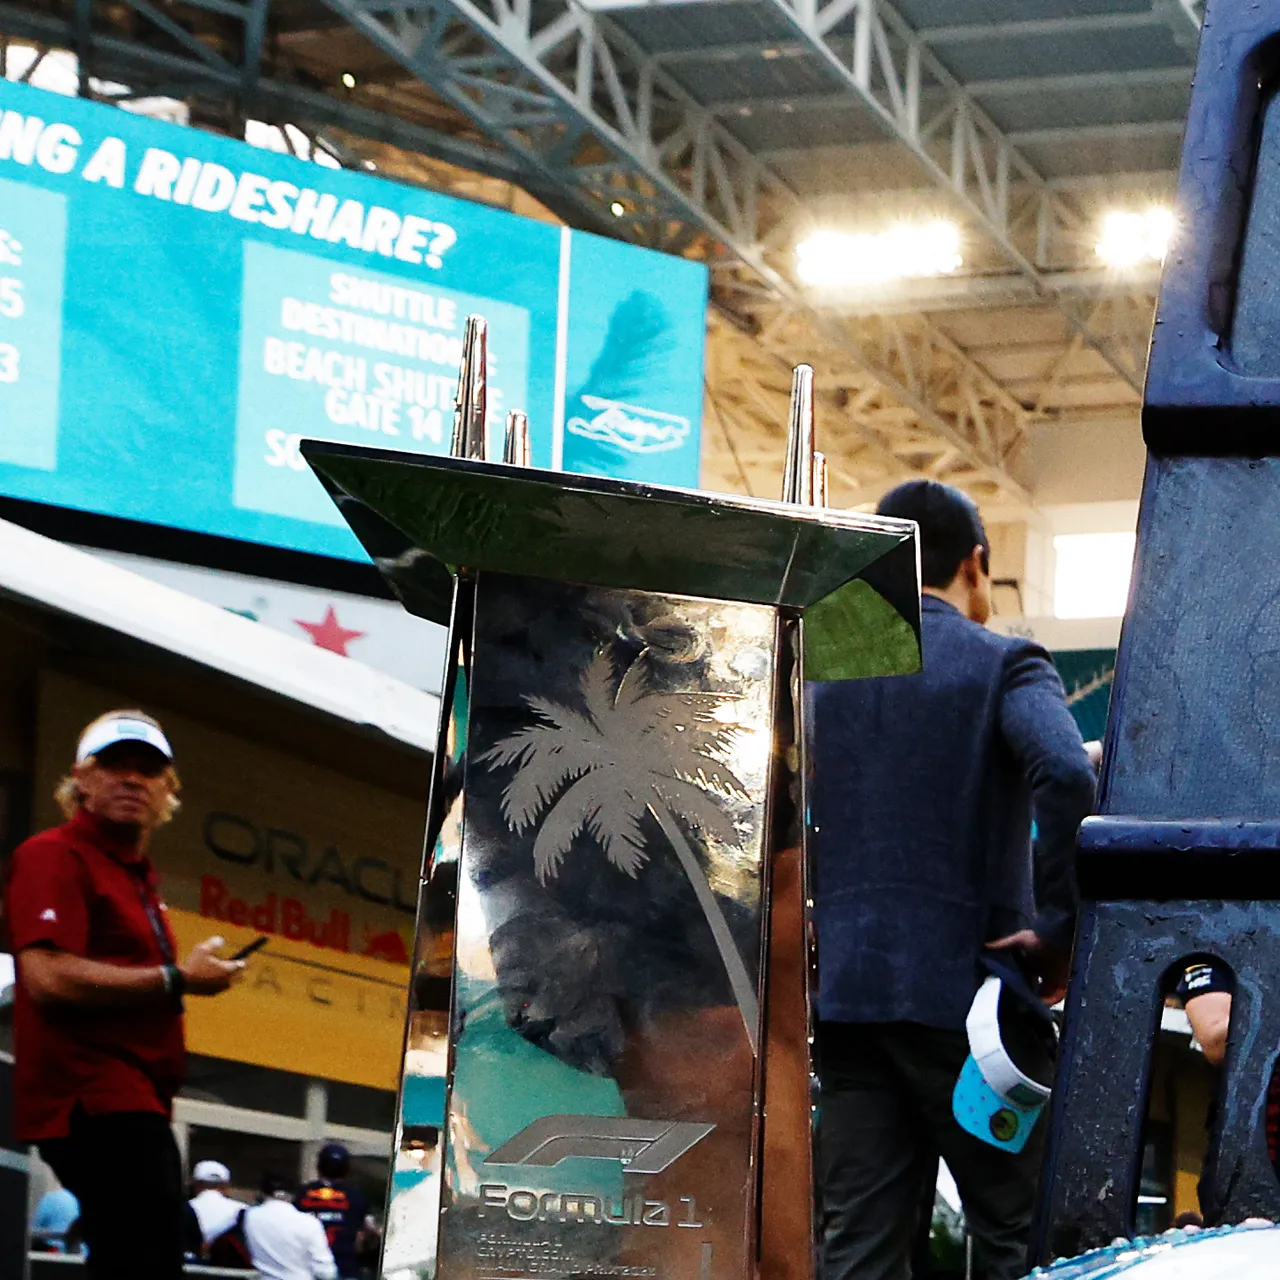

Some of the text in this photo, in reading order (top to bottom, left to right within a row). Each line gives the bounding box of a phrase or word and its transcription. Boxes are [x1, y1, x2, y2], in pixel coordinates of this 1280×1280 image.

[0, 110, 457, 269] NG A RIDESHARE?
[329, 273, 457, 330] SHUTTLE
[263, 336, 367, 391] BEACH
[325, 387, 443, 444] GATE 14
[204, 810, 417, 915] ORACL
